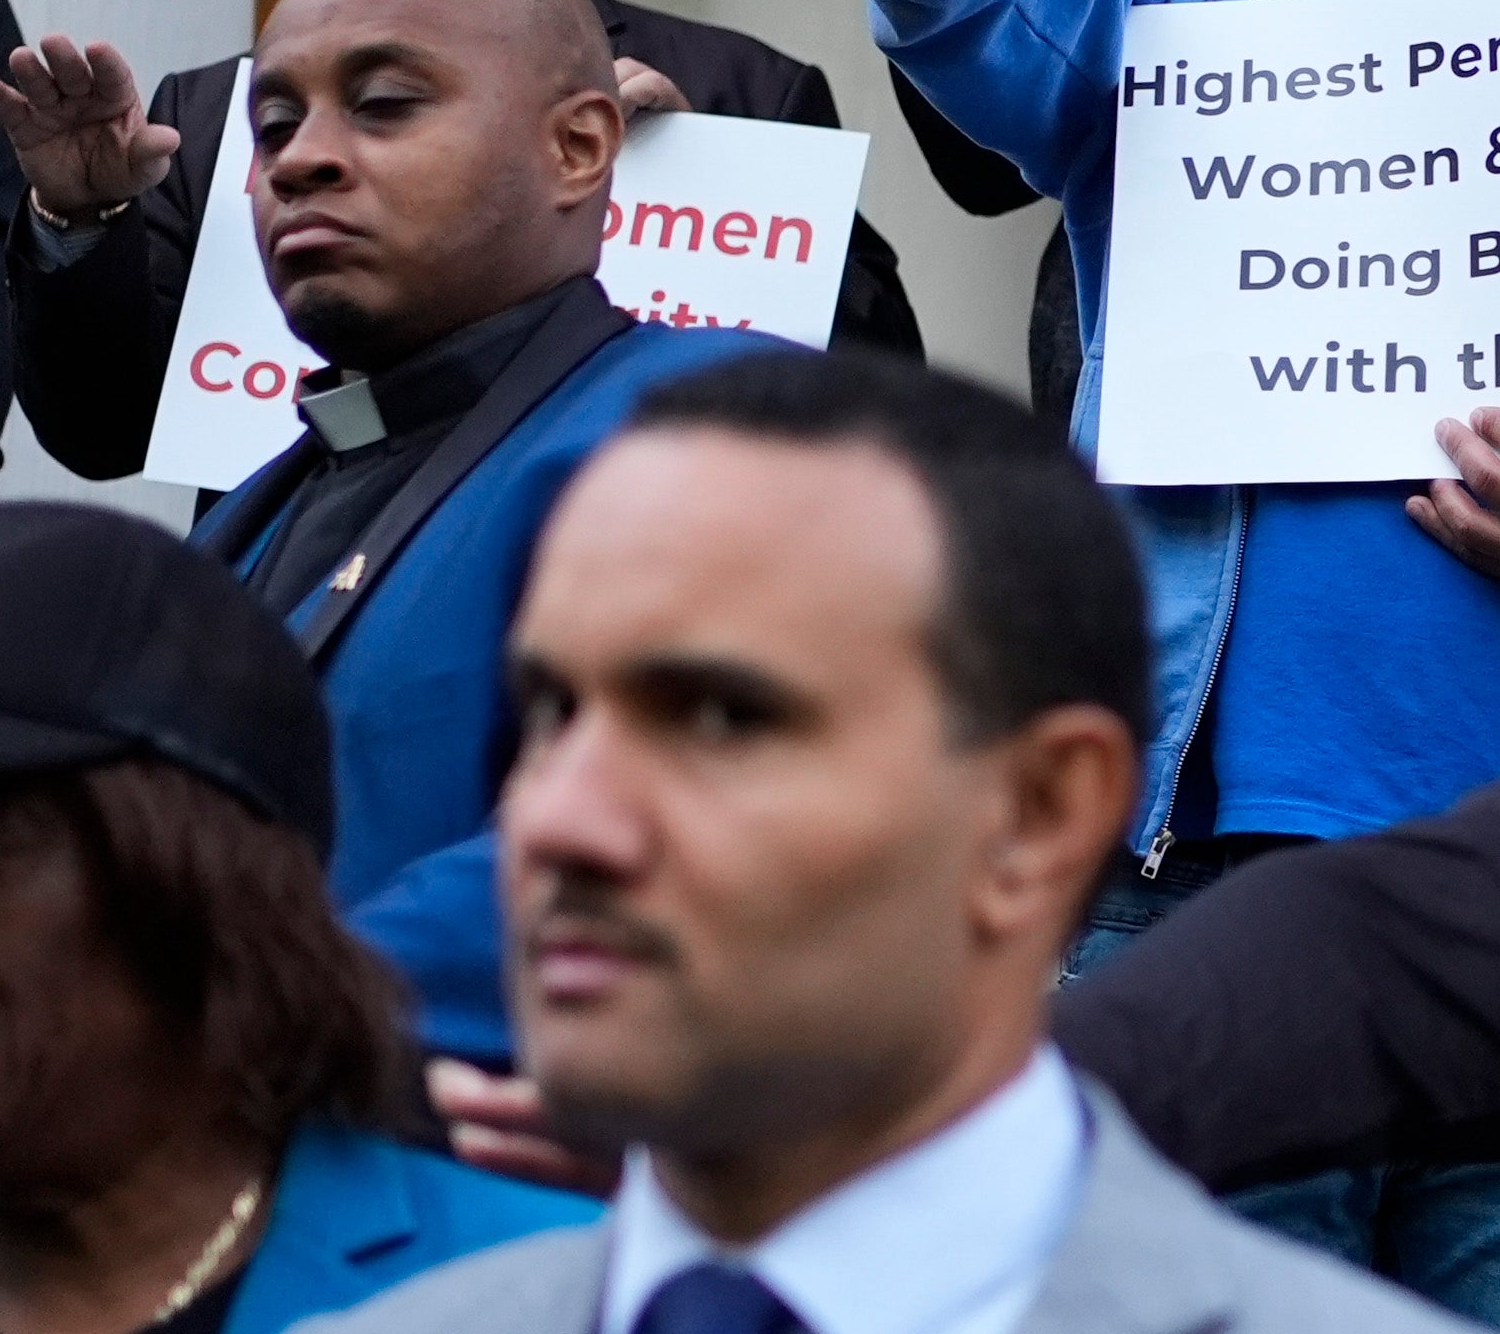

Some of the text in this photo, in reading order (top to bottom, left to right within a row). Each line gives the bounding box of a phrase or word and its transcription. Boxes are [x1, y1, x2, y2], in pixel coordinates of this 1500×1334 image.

[1123, 53, 1383, 116] Highest
[1182, 147, 1459, 200] Women
[1239, 242, 1440, 296] Doing
[1250, 341, 1426, 393] with
